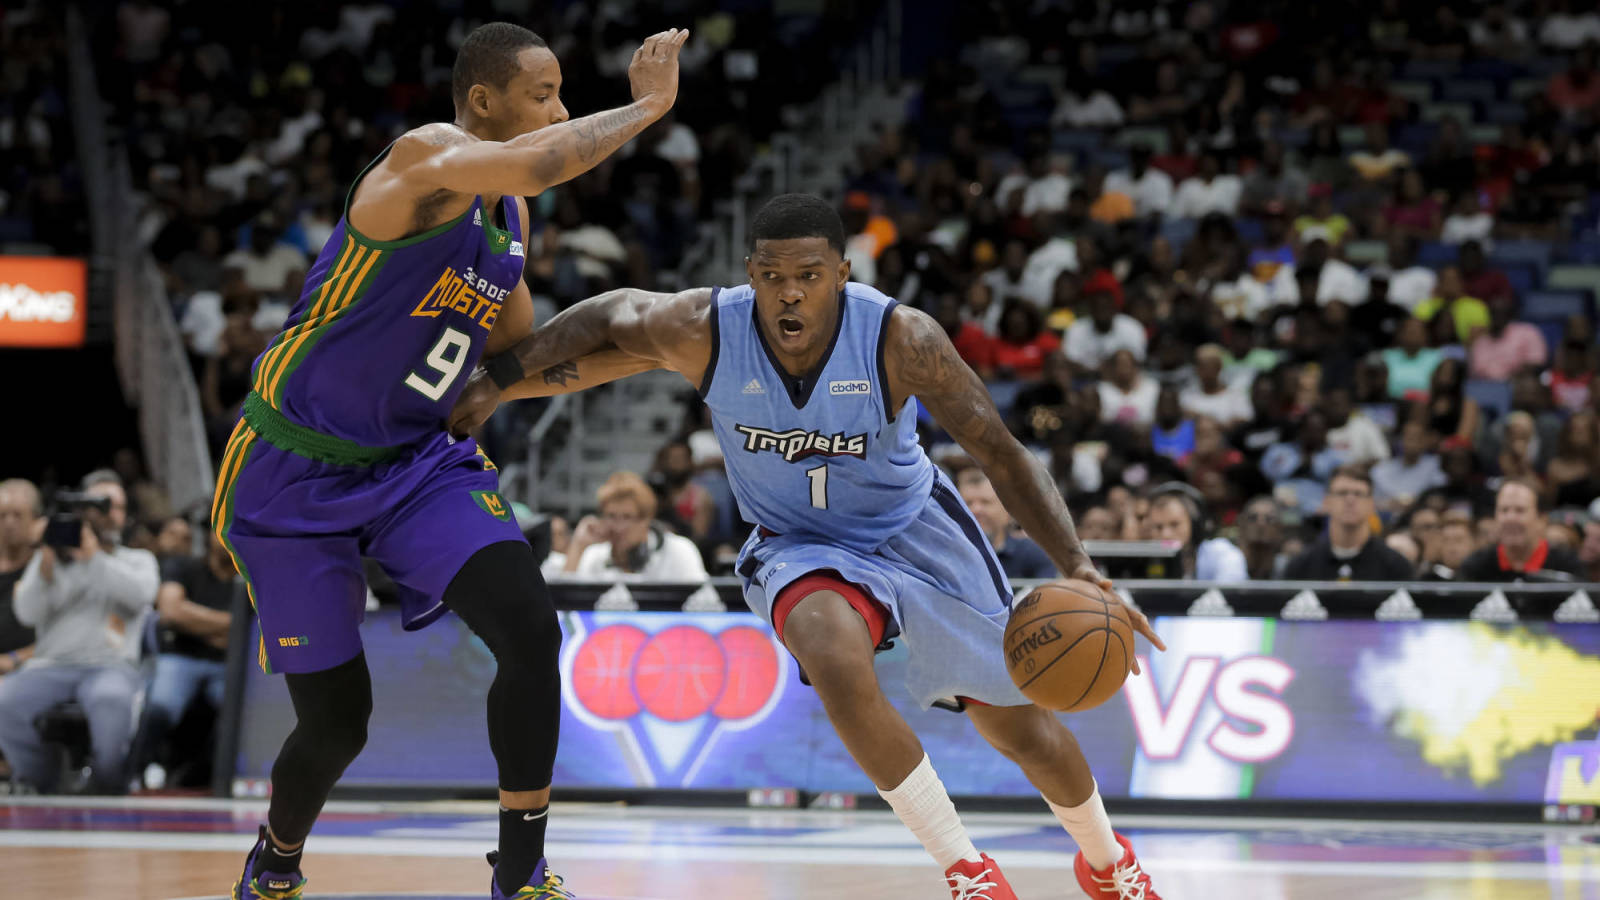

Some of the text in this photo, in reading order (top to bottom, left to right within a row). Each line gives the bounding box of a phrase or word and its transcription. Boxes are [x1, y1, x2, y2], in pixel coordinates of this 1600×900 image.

[404, 327, 471, 401] 9
[831, 383, 868, 393] cbdMD
[735, 424, 867, 463] Triplets
[806, 464, 829, 509] 1
[278, 635, 309, 647] BIG3
[1123, 655, 1296, 763] VS
